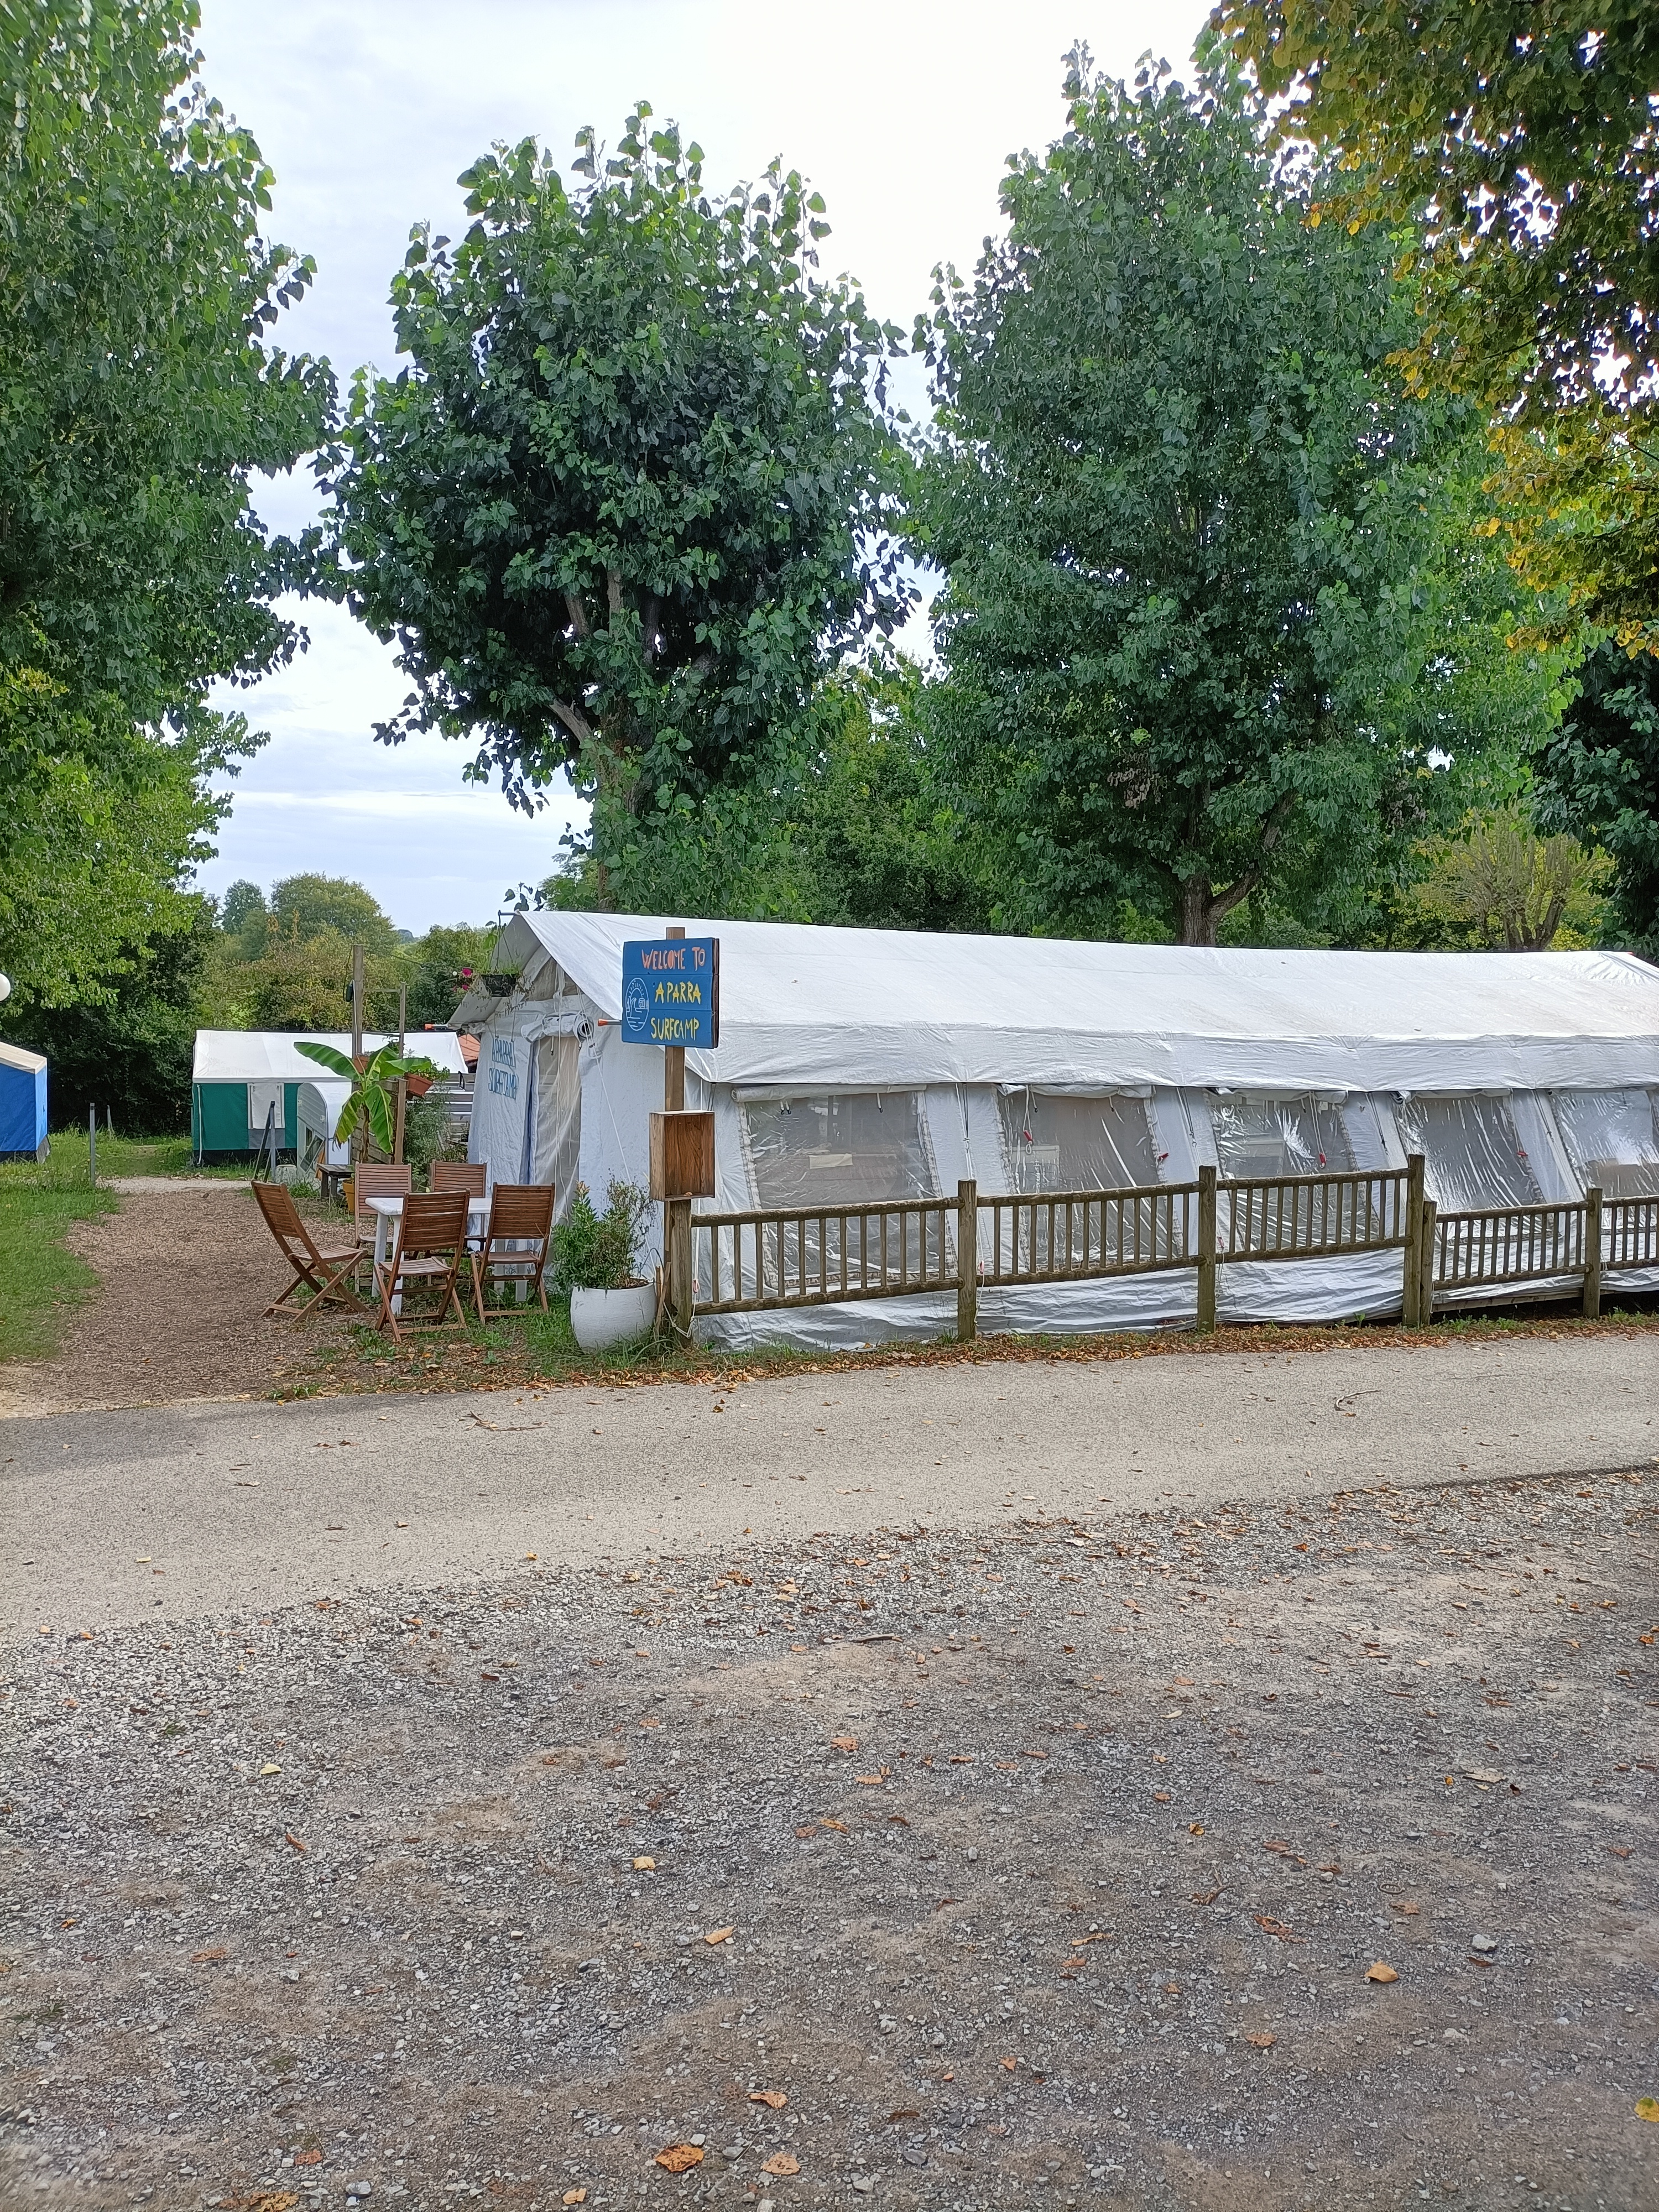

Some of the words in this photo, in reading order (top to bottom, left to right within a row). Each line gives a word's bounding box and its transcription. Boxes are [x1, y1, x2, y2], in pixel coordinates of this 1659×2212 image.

[641, 948, 686, 969] WELCOME
[692, 946, 706, 971] TO
[650, 1017, 700, 1041] SURFCAMP
[492, 1038, 516, 1068] APARRA
